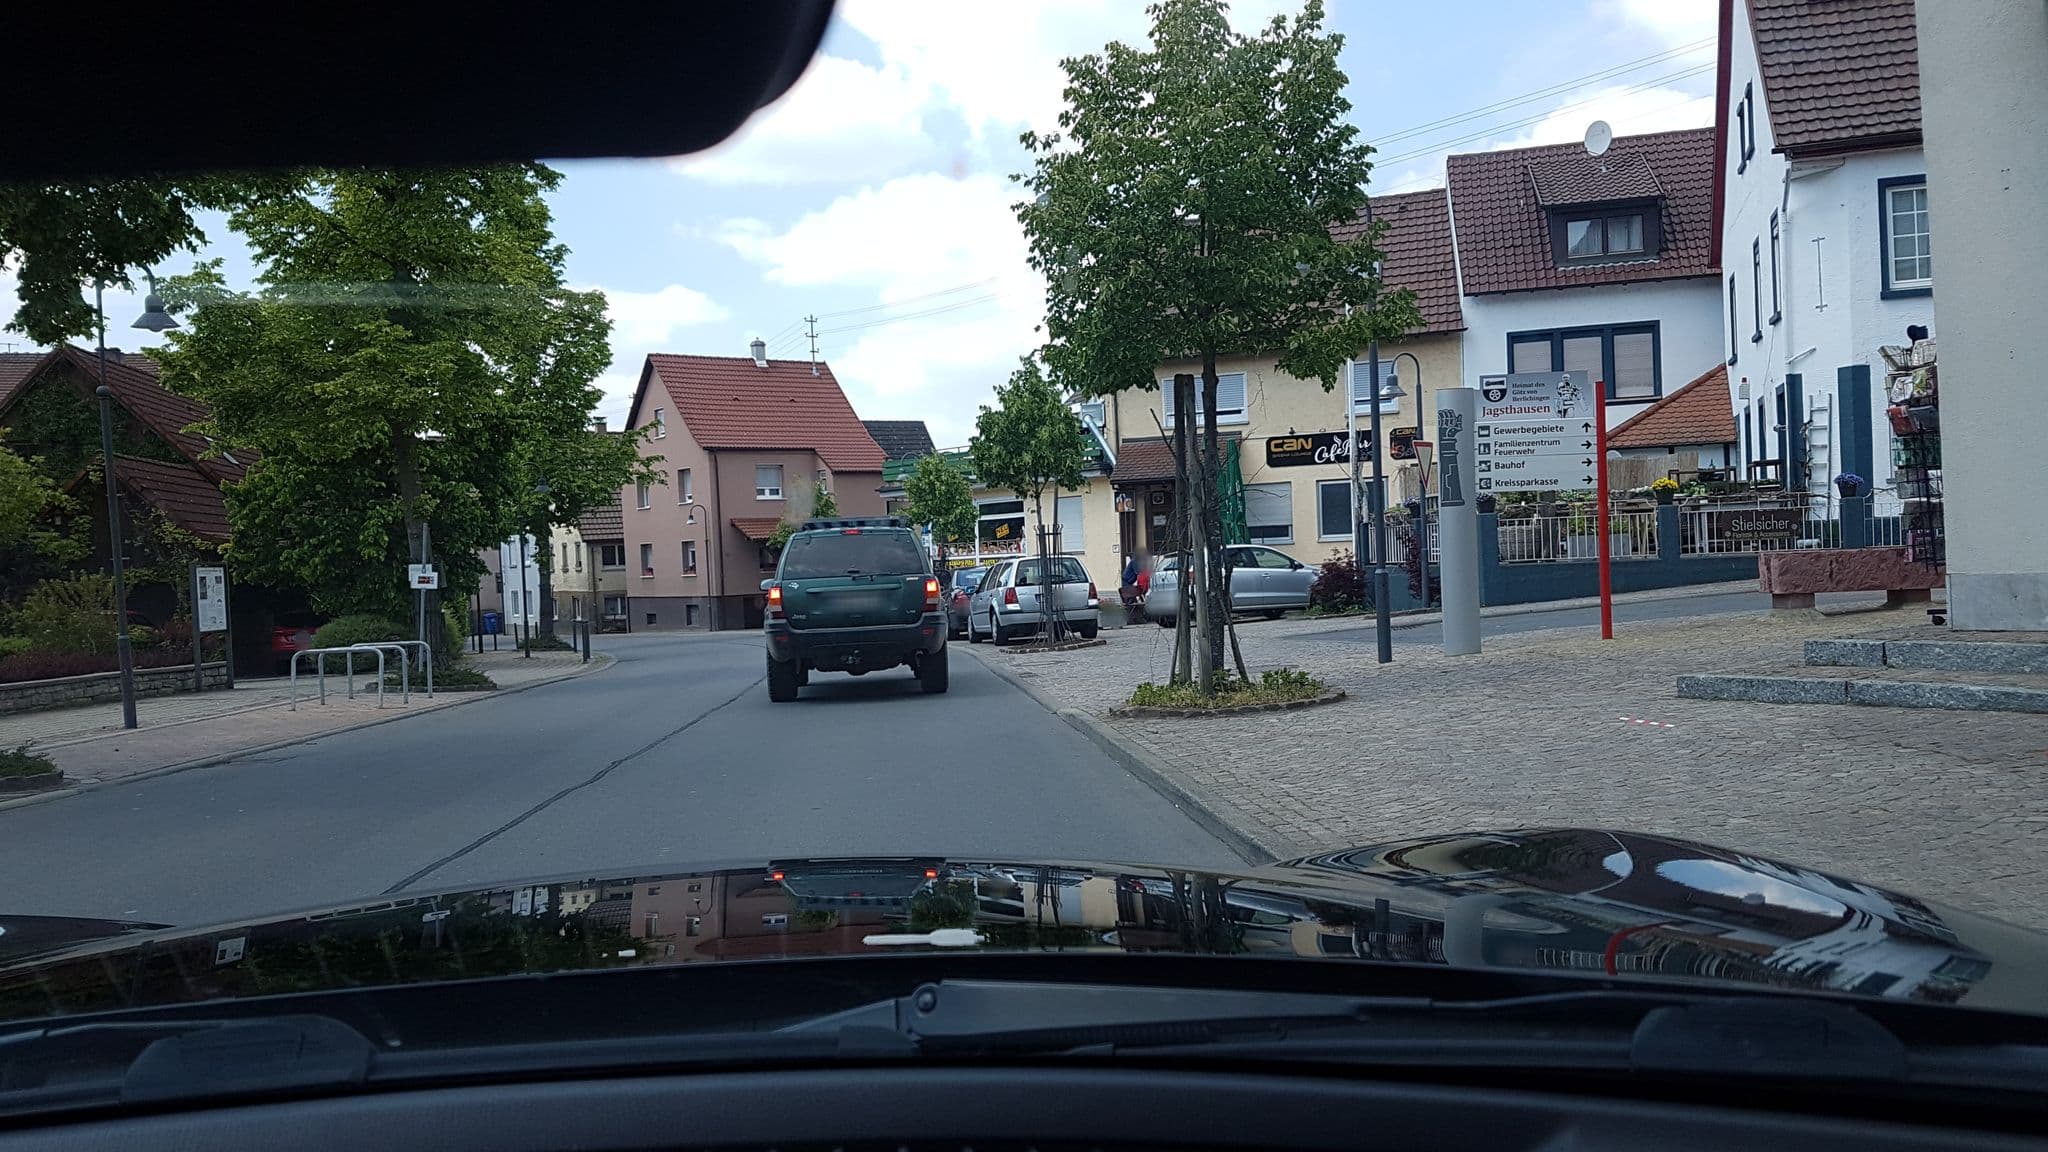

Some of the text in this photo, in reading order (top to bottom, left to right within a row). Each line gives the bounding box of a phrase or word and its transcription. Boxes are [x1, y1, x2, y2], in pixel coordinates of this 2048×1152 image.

[1482, 405, 1551, 418] Jagsthausen
[1493, 425, 1565, 435] Gewerbegebiete
[1494, 439, 1561, 448] Familienzentrum
[1494, 448, 1536, 456] Feuerwehr
[1494, 460, 1525, 470] Bauhof
[1495, 478, 1559, 488] Kreissparkasse
[1731, 511, 1790, 531] Stielsicher
